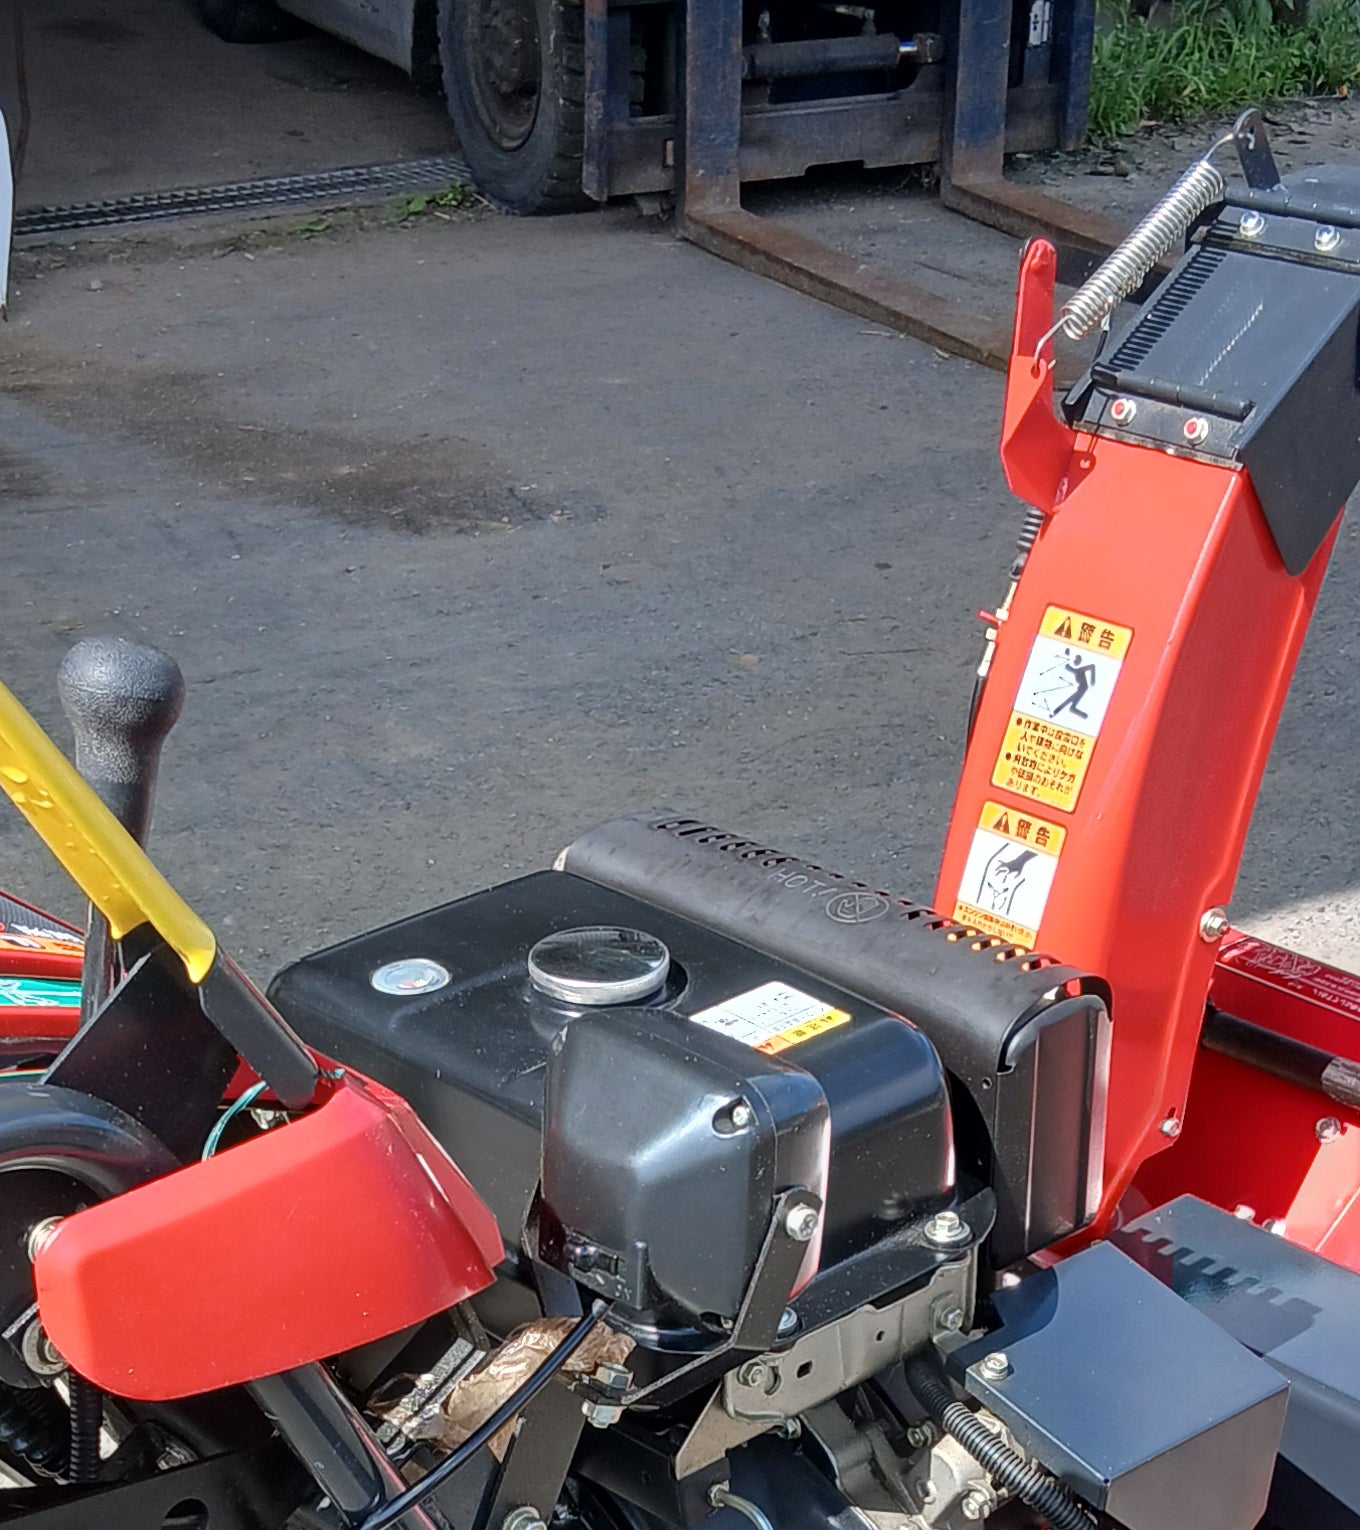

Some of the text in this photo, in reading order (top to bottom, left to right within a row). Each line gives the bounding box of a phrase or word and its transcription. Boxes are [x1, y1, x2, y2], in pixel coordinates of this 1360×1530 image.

[1078, 622, 1115, 650] 警告
[1016, 818, 1051, 848] 警告
[767, 868, 838, 898] HOT!
